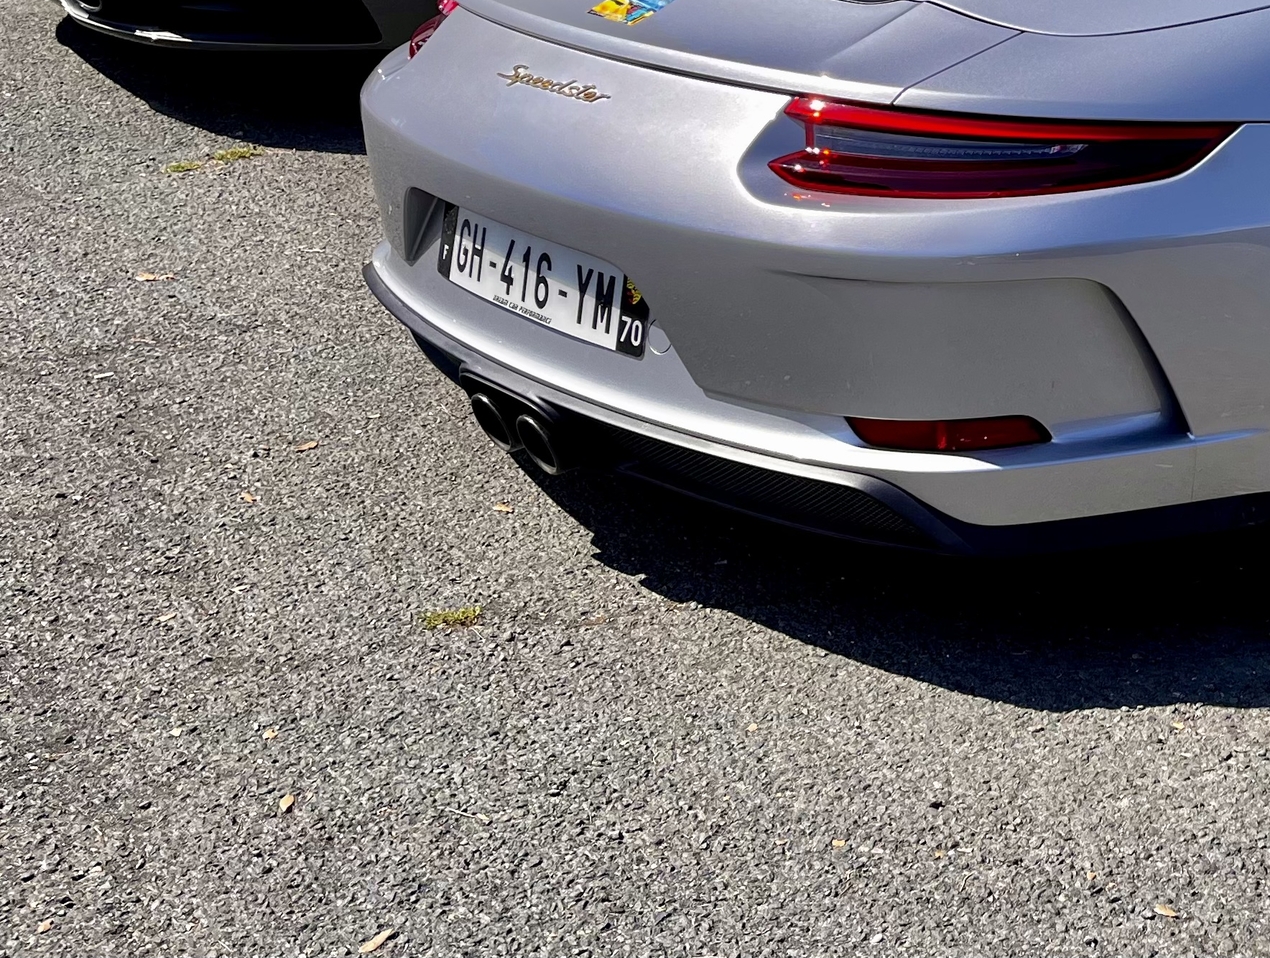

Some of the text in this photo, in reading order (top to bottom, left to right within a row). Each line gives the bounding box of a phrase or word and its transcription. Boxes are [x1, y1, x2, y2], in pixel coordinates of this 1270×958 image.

[497, 64, 611, 103] Speedster
[442, 244, 450, 260] F
[456, 218, 617, 335] GH-416-YM
[619, 316, 643, 347] 70
